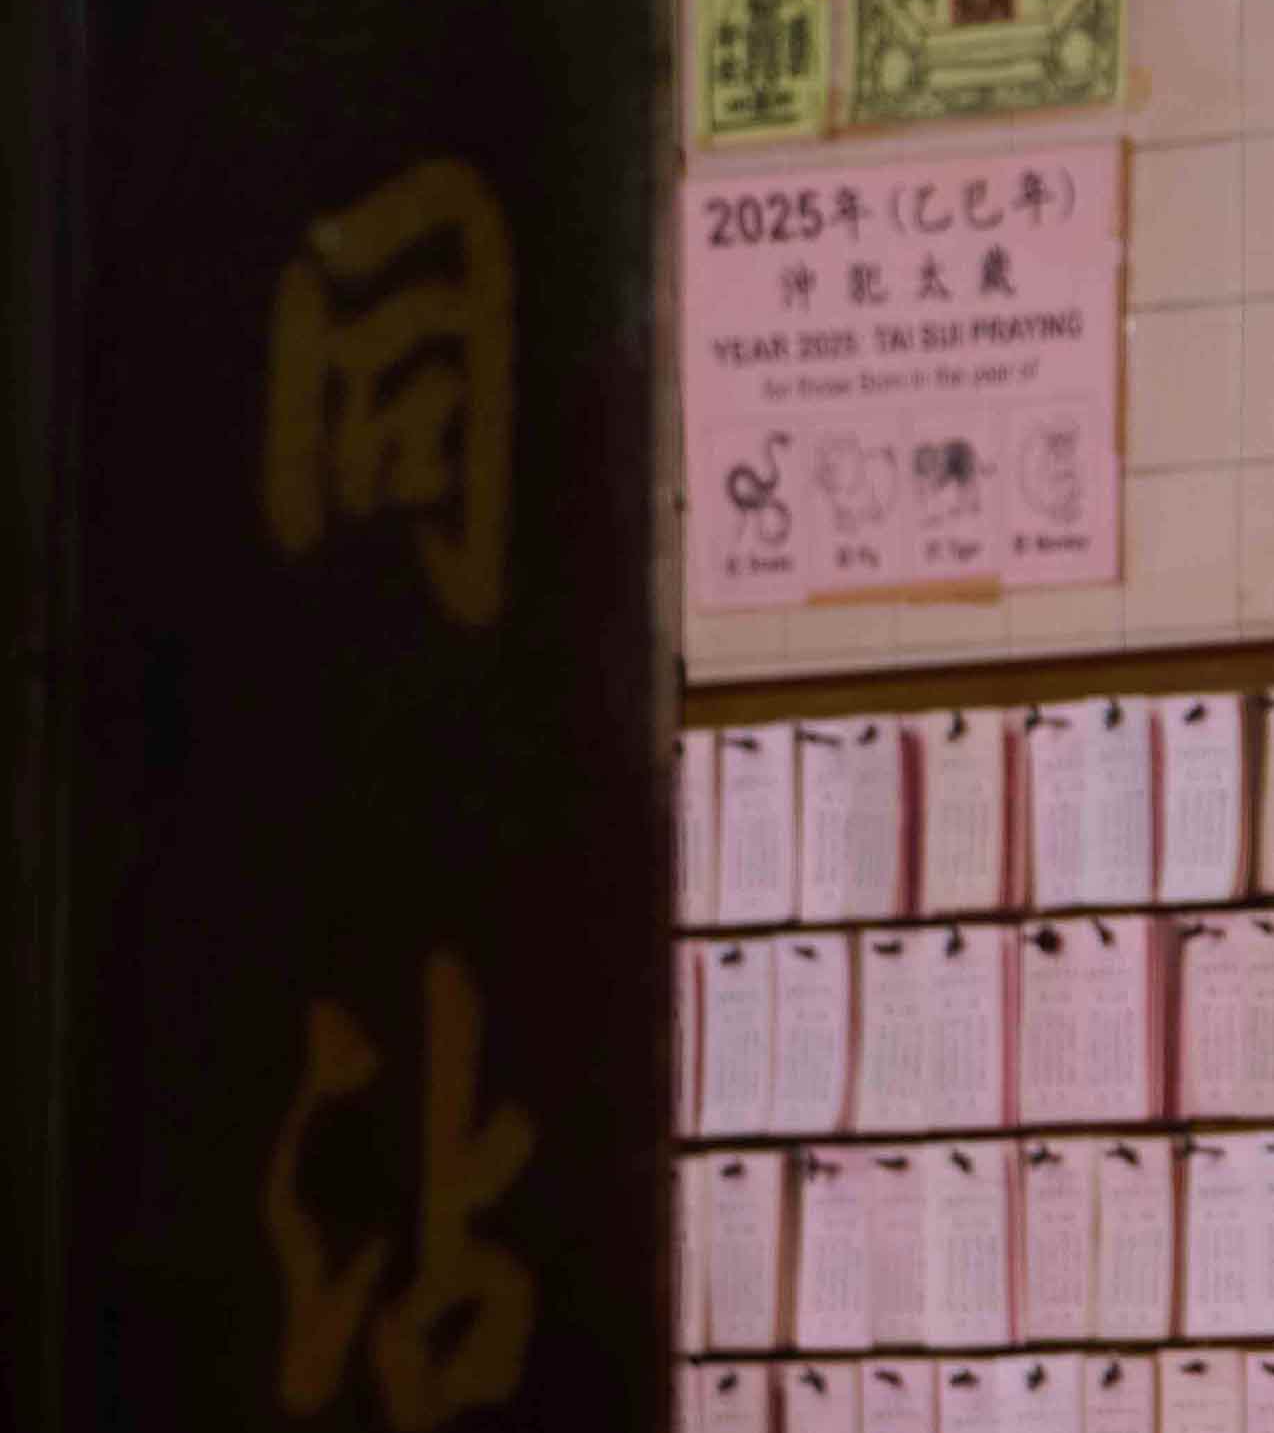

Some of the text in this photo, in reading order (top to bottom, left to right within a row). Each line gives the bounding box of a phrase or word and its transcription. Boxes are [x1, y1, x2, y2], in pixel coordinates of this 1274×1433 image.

[712, 308, 1085, 366] YEAR 2025 TAI SUI PRAYING
